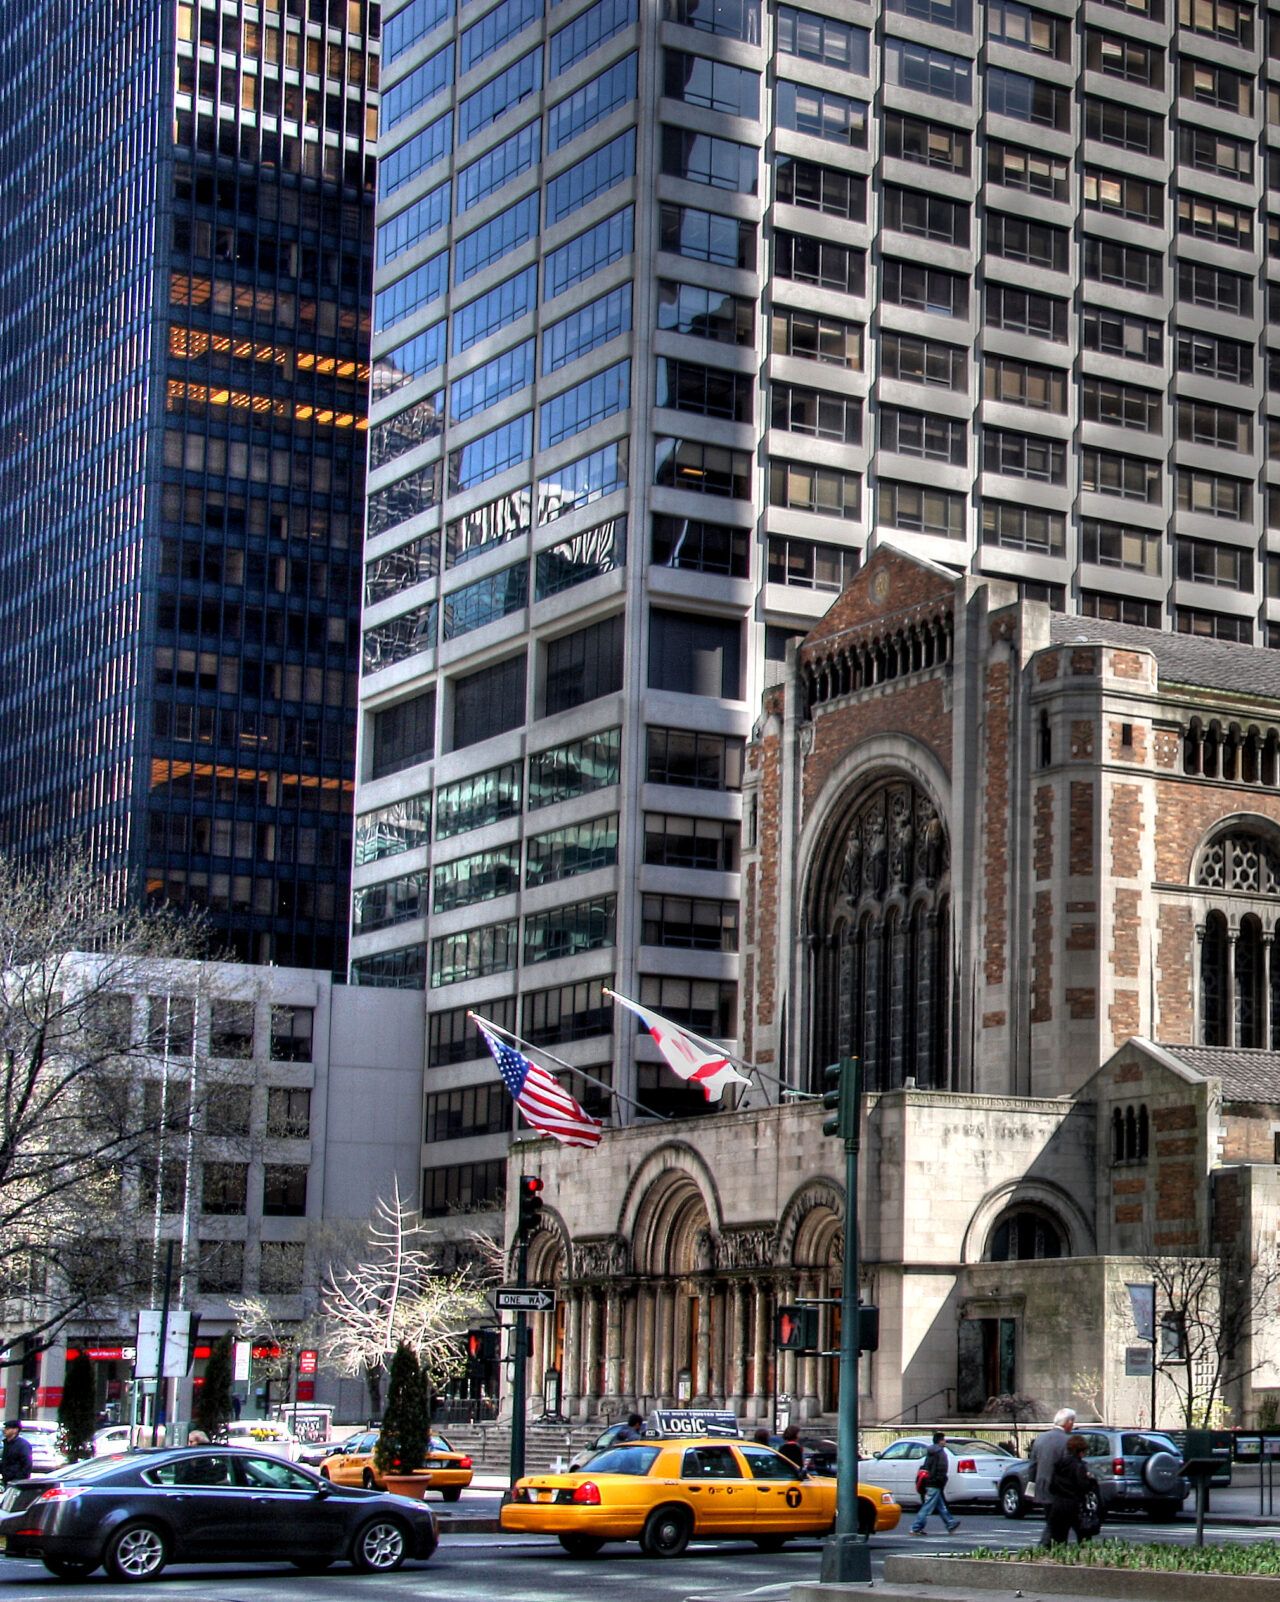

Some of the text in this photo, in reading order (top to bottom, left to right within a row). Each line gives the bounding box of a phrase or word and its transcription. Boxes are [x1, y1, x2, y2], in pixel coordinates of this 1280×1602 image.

[1014, 1100, 1044, 1109] CHRIST
[503, 1295, 547, 1304] ONE WAY
[661, 1418, 707, 1433] LOGIC
